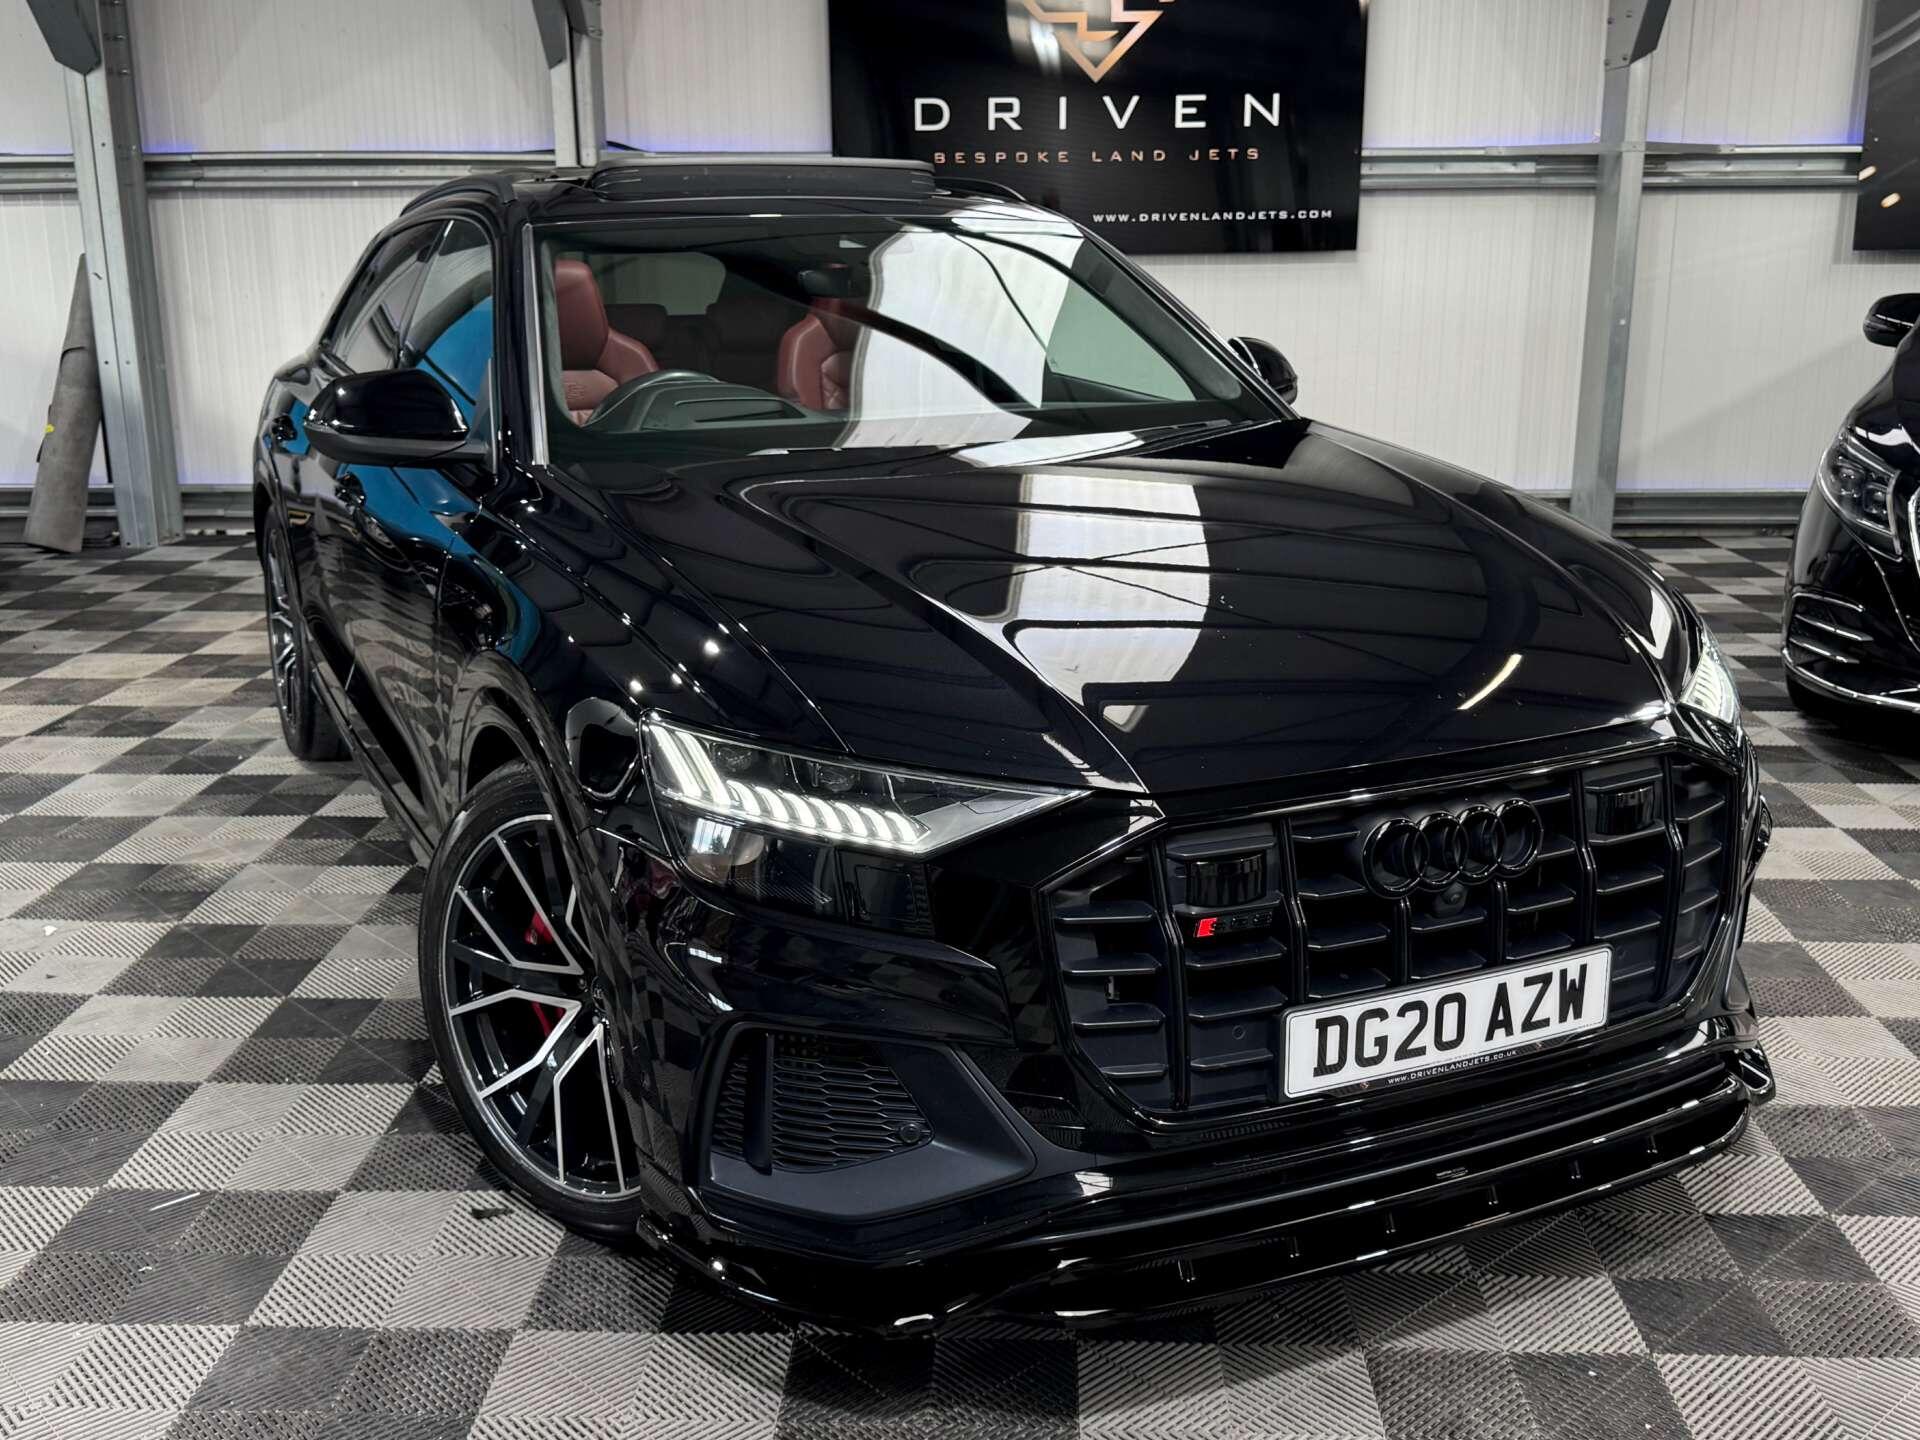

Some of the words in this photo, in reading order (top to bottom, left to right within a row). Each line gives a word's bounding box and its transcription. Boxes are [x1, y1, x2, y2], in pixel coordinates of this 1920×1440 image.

[914, 92, 1280, 131] DRIVEN
[933, 150, 1070, 164] BESPOKE
[1091, 149, 1167, 163] LAND
[1188, 147, 1260, 162] JETS
[1092, 209, 1333, 222] WWW.DRIVENLANDJETS.COM
[1312, 992, 1467, 1078] DG20
[1484, 963, 1588, 1043] AZW
